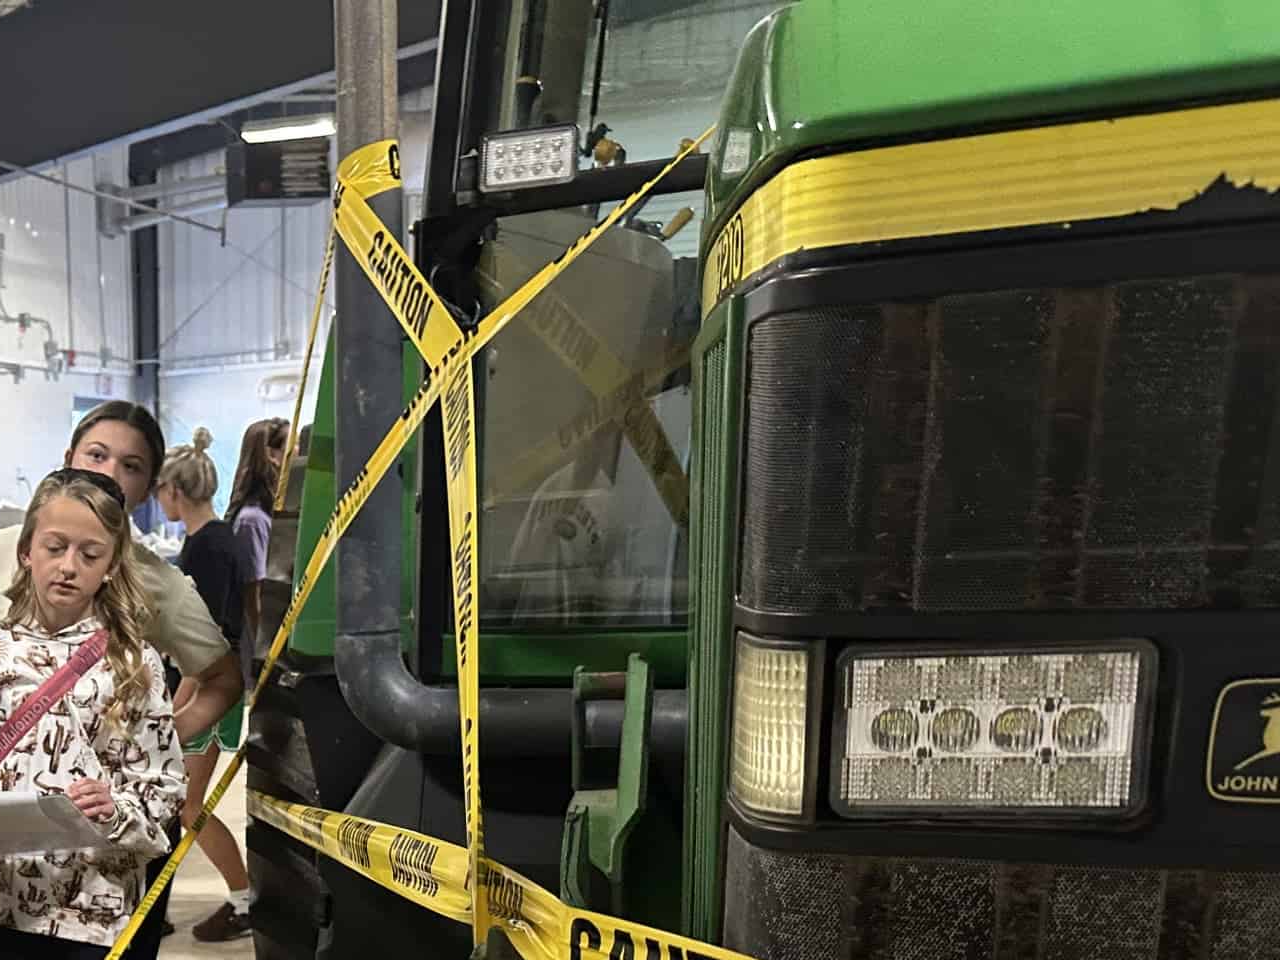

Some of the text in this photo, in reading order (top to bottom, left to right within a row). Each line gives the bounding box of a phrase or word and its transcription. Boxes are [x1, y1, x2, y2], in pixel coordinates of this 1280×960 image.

[368, 231, 434, 341] CAUTION
[1217, 775, 1278, 792] JOHN
[389, 832, 439, 897] CAUTION
